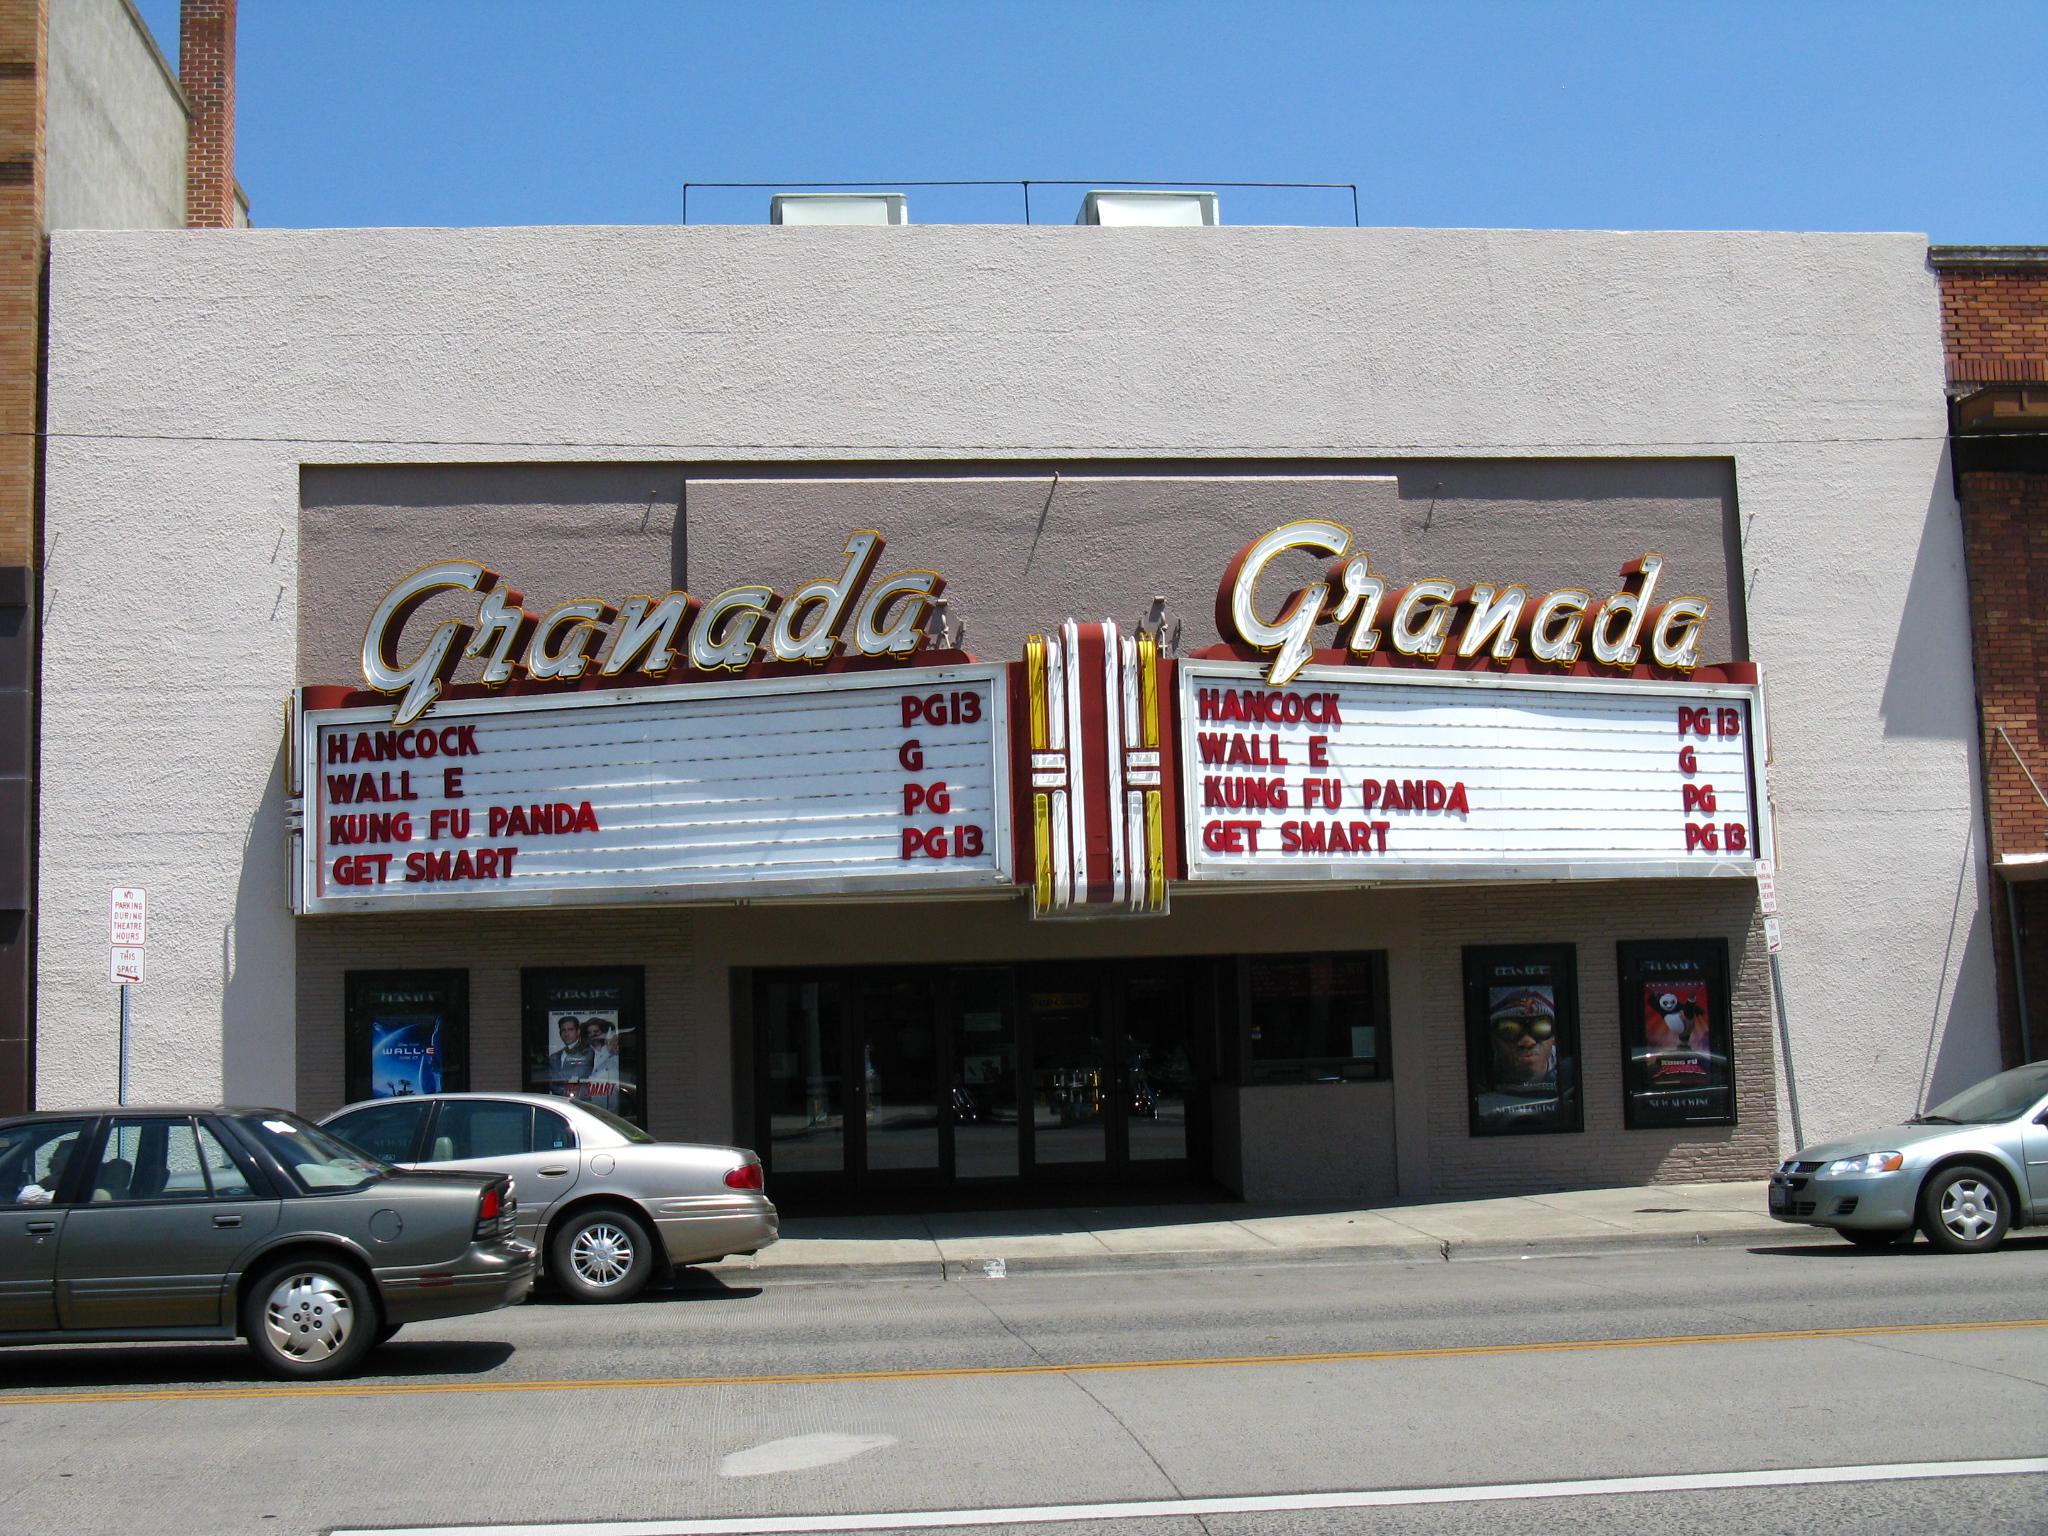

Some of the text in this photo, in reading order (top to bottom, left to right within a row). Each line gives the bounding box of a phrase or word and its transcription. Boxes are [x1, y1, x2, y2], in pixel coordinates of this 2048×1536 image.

[1218, 518, 1713, 687] Granada
[361, 529, 944, 727] Granada
[1200, 688, 1342, 725] HANCOCK
[327, 725, 480, 764] HANCOCK
[899, 739, 924, 771] G
[1198, 732, 1329, 767] WALL E
[1679, 745, 1697, 774] G
[327, 767, 464, 804] WALL E
[903, 782, 951, 816] PG
[1204, 775, 1470, 813] KUNG FU PANDA
[1682, 783, 1717, 813] PG
[330, 801, 600, 845] KUNG FU PANDA
[1203, 819, 1391, 853] GET SMART
[333, 847, 519, 886] GET SMART
[114, 901, 143, 910] PARKING
[114, 912, 143, 920] DURING
[113, 922, 143, 931] THEATRE
[115, 933, 140, 941] HOURS
[116, 965, 138, 974] SPACE
[120, 952, 136, 961] THIS
